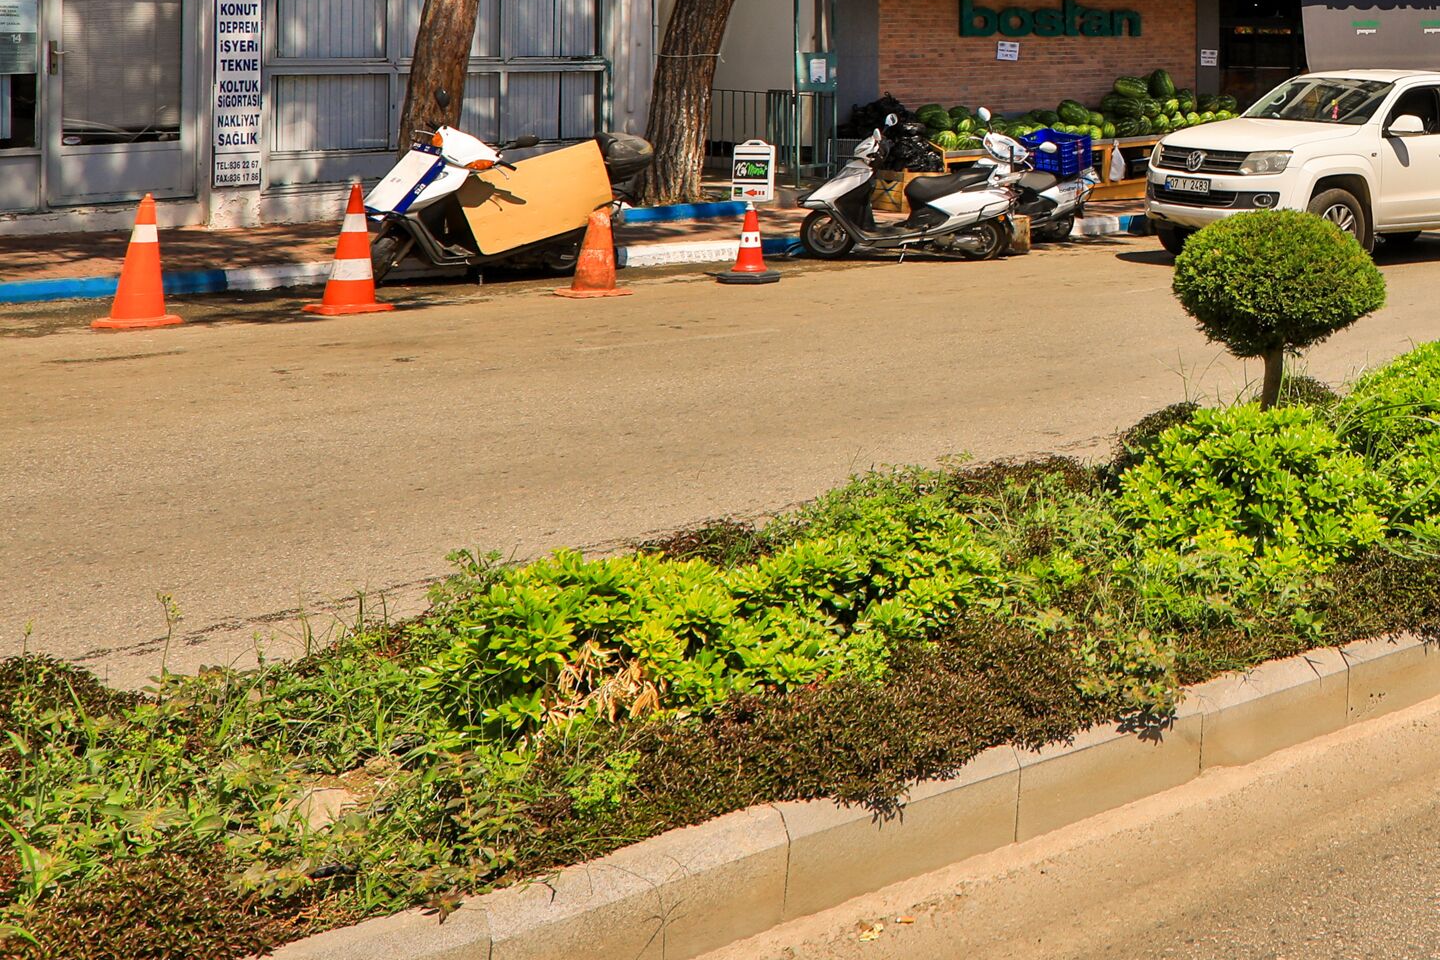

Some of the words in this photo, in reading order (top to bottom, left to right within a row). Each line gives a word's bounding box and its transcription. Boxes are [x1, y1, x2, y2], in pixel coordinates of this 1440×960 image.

[221, 3, 258, 16] KONUT
[220, 21, 259, 34] DEPREM
[221, 59, 258, 72] TEKNE
[220, 80, 259, 93] KOLTUK
[218, 131, 258, 146] SAĞLIK
[242, 160, 250, 169] 22
[251, 160, 259, 169] 67
[242, 172, 250, 182] 17
[1170, 178, 1179, 189] 07
[1182, 179, 1187, 189] Y
